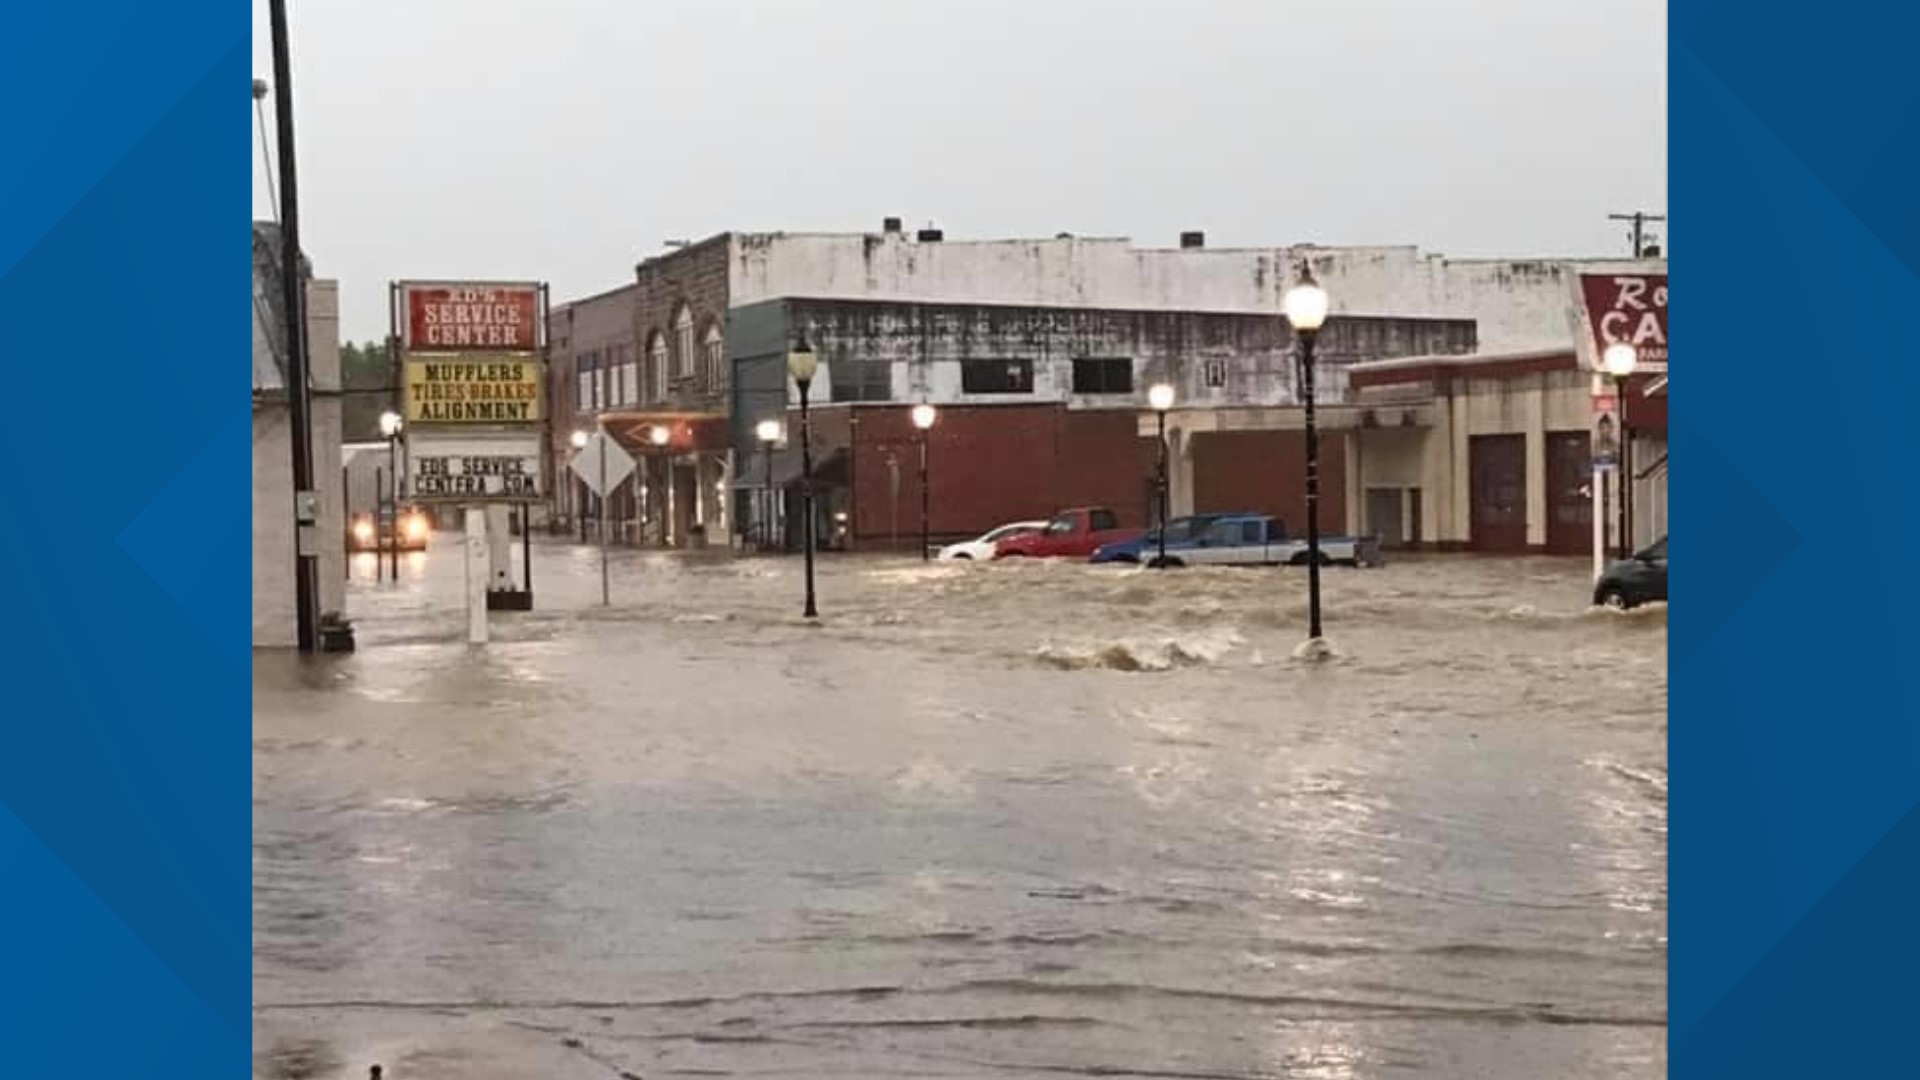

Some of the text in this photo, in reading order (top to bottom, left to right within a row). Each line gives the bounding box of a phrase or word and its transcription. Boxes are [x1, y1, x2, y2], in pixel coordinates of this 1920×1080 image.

[424, 304, 521, 324] SERVICE
[428, 325, 518, 345] CENTER
[424, 364, 523, 381] MUFFLERS
[419, 402, 529, 420] ALIGNMENT
